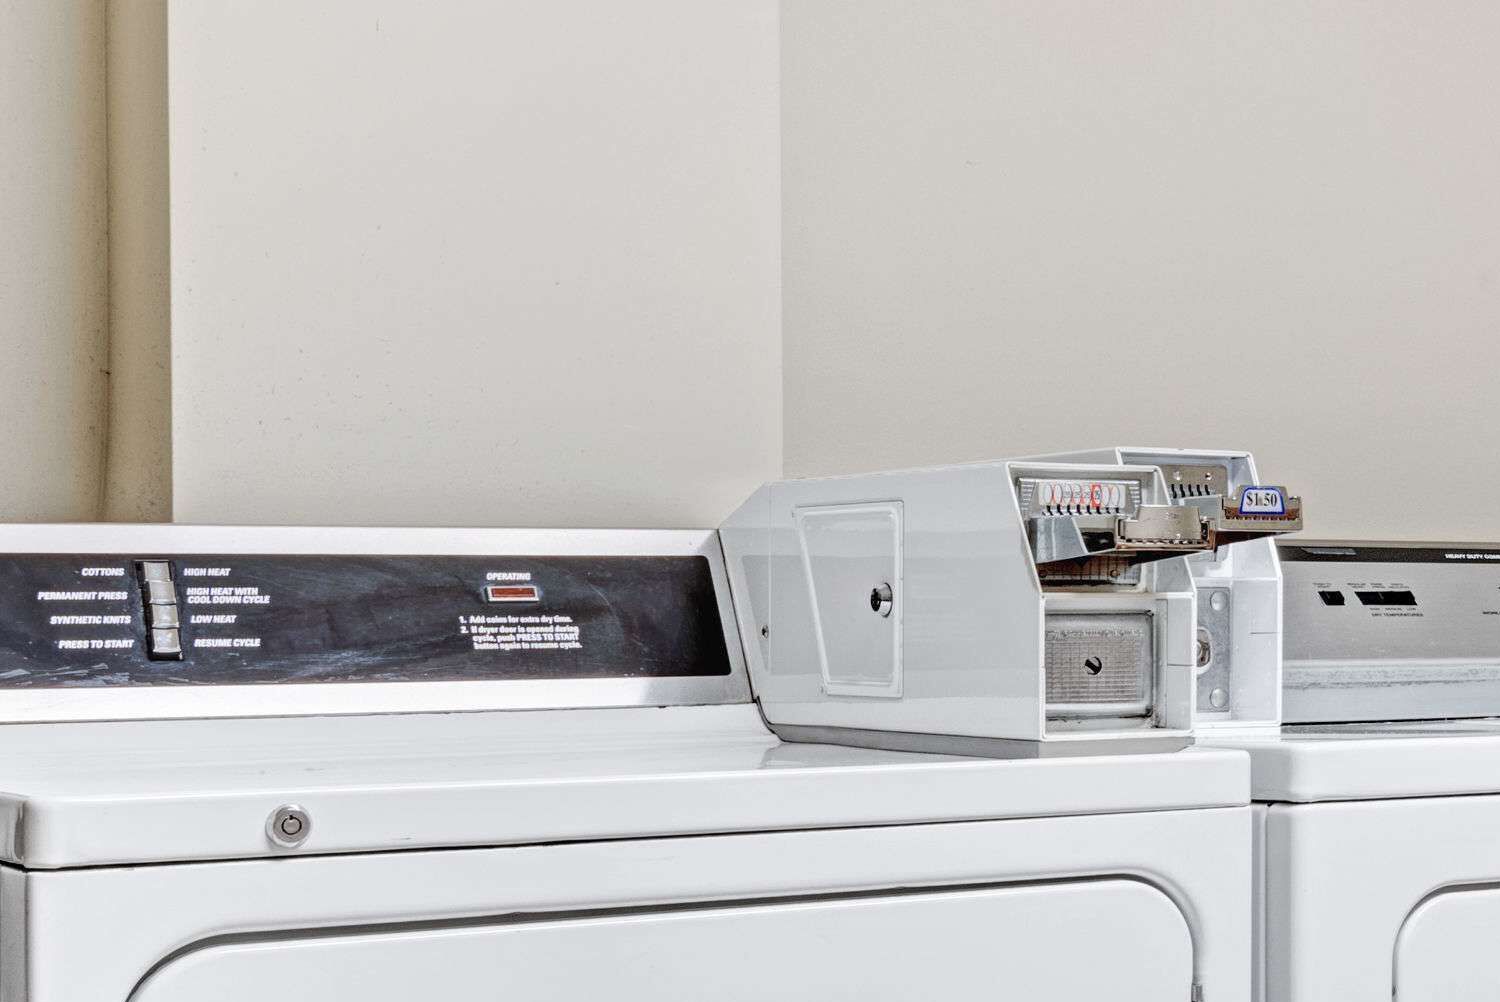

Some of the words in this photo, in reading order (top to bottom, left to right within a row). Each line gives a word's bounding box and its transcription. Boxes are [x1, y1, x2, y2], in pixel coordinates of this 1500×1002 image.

[81, 568, 125, 577] COTTONS
[184, 568, 206, 577] HIGH
[207, 568, 231, 577] HEAT
[486, 572, 531, 581] OPERATING
[38, 591, 98, 600] PERMANENT
[98, 592, 128, 600] PRESS
[186, 587, 210, 596] HIGH
[211, 587, 233, 596] HEAT
[234, 587, 259, 596] WITH
[188, 596, 212, 604] COOL
[212, 596, 242, 604] DOWN
[243, 596, 270, 604] CYCLE
[50, 616, 102, 625] SYNTHETIC
[103, 616, 131, 625] KNITS
[190, 615, 212, 624] LOW
[213, 615, 237, 624] HEAT
[508, 615, 520, 623] for
[541, 615, 554, 624] dry
[554, 615, 573, 623] time.
[460, 626, 469, 634] 2.
[470, 626, 478, 634] If
[478, 626, 498, 635] dryer
[526, 626, 553, 634] opened
[555, 626, 579, 634] during
[472, 634, 496, 643] cycle,
[497, 634, 515, 642] push
[58, 640, 90, 649] PRESS
[90, 640, 104, 649] TO
[104, 640, 135, 649] START
[194, 639, 233, 648] RESUME
[233, 639, 261, 647] CYCLE
[474, 642, 499, 650] button
[500, 642, 521, 650] again
[560, 641, 583, 650] cycle.
